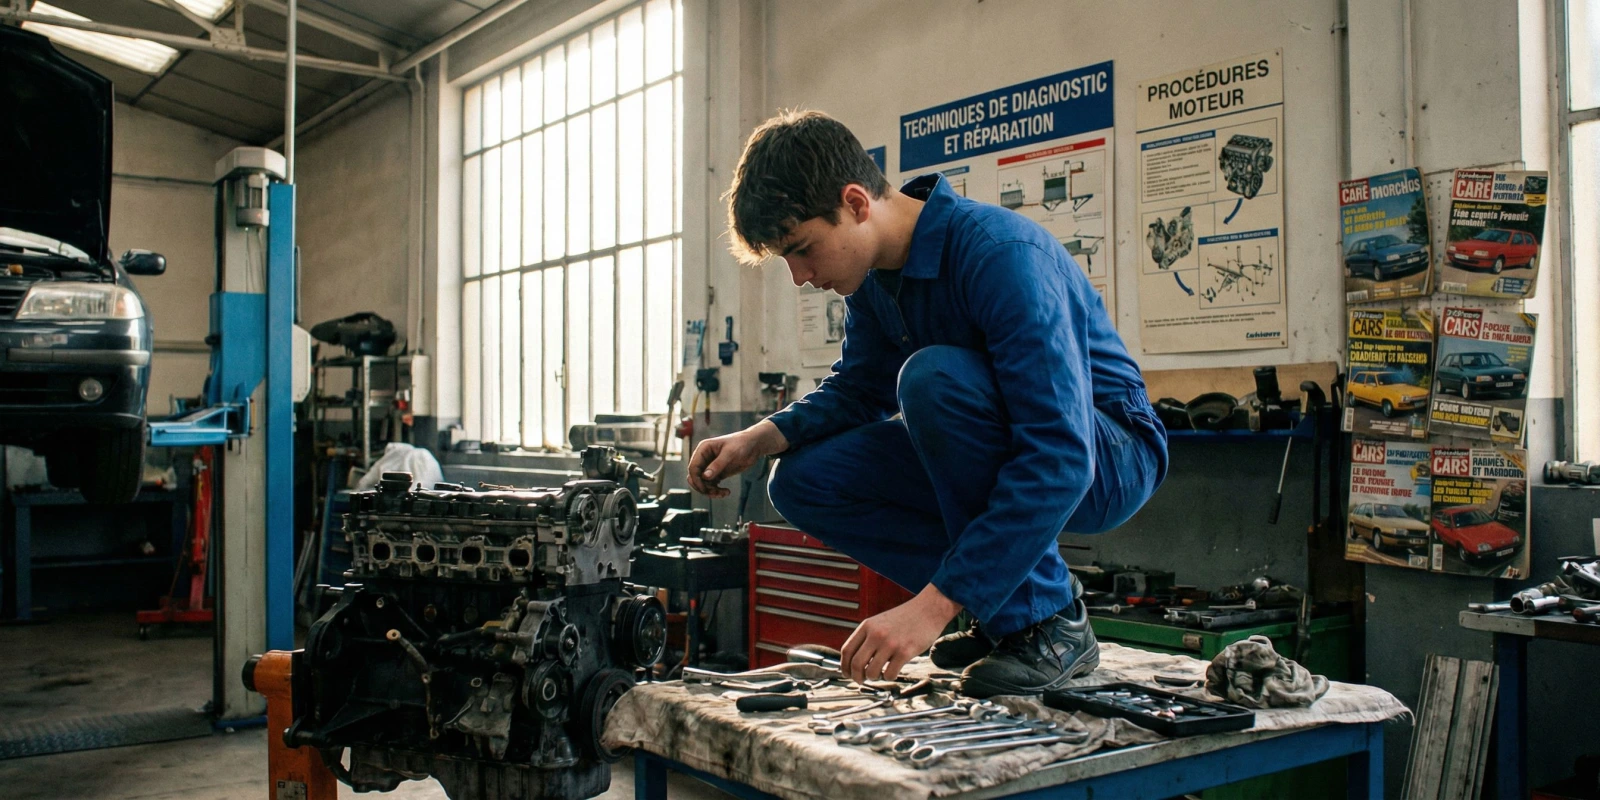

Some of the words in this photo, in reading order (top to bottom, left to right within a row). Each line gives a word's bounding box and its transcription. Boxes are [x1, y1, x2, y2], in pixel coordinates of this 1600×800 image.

[1148, 59, 1269, 102] PROCÉDURES
[904, 102, 984, 139] TECHNIQUES
[989, 96, 1008, 118] DE
[1012, 71, 1107, 113] DIAGNOSTIC
[1169, 88, 1244, 119] MOTEUR
[944, 134, 960, 155] ET
[964, 112, 1054, 150] RÉPARATION
[1456, 180, 1491, 199] CARE
[1353, 319, 1383, 336] CARS
[1444, 316, 1479, 337] CARS
[1353, 444, 1384, 463] CARS
[1433, 457, 1468, 475] CARS
